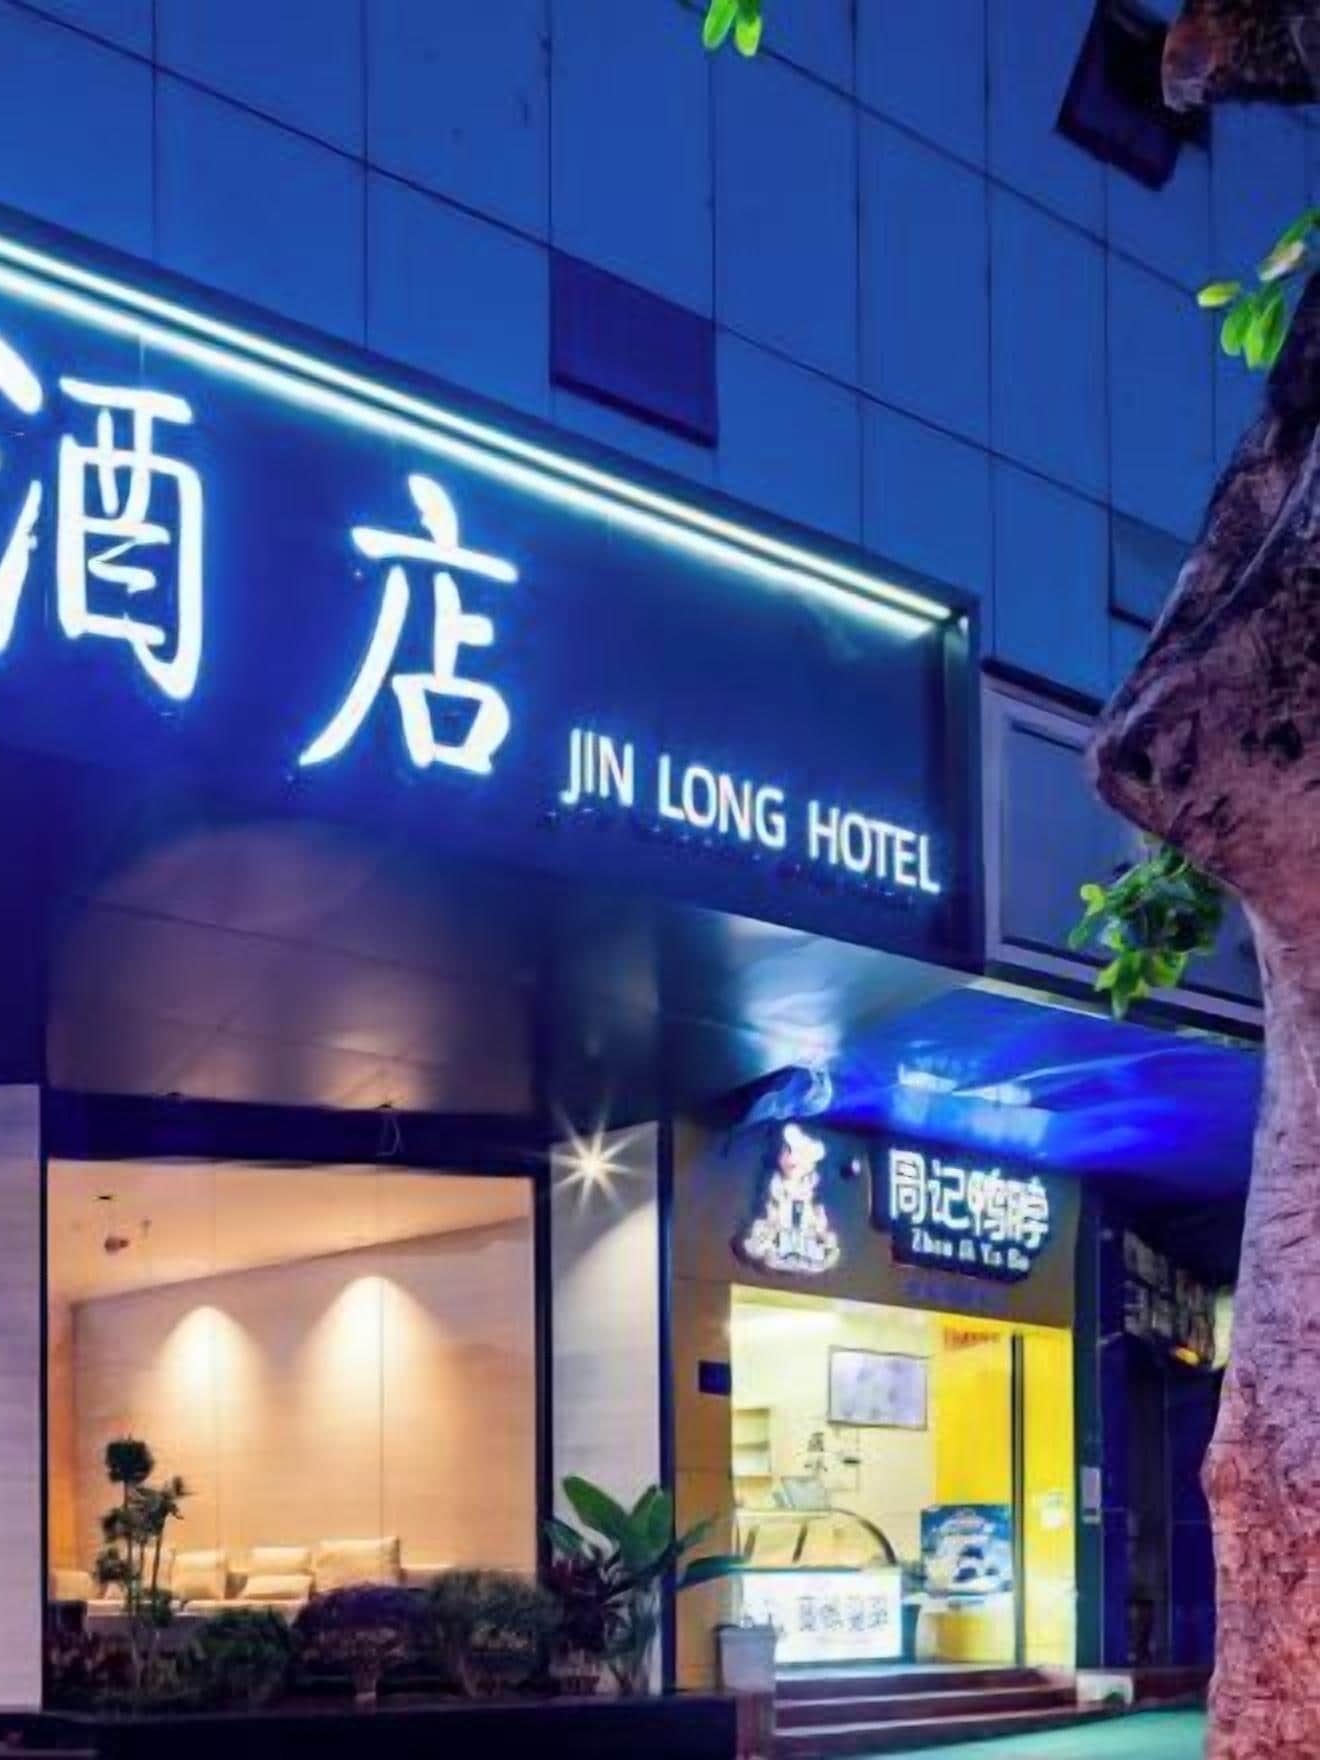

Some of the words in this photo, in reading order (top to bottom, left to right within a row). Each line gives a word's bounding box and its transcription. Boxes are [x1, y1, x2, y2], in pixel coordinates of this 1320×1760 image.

[559, 727, 634, 808] JIN
[657, 752, 787, 850] LONG
[808, 799, 941, 895] HOTEL
